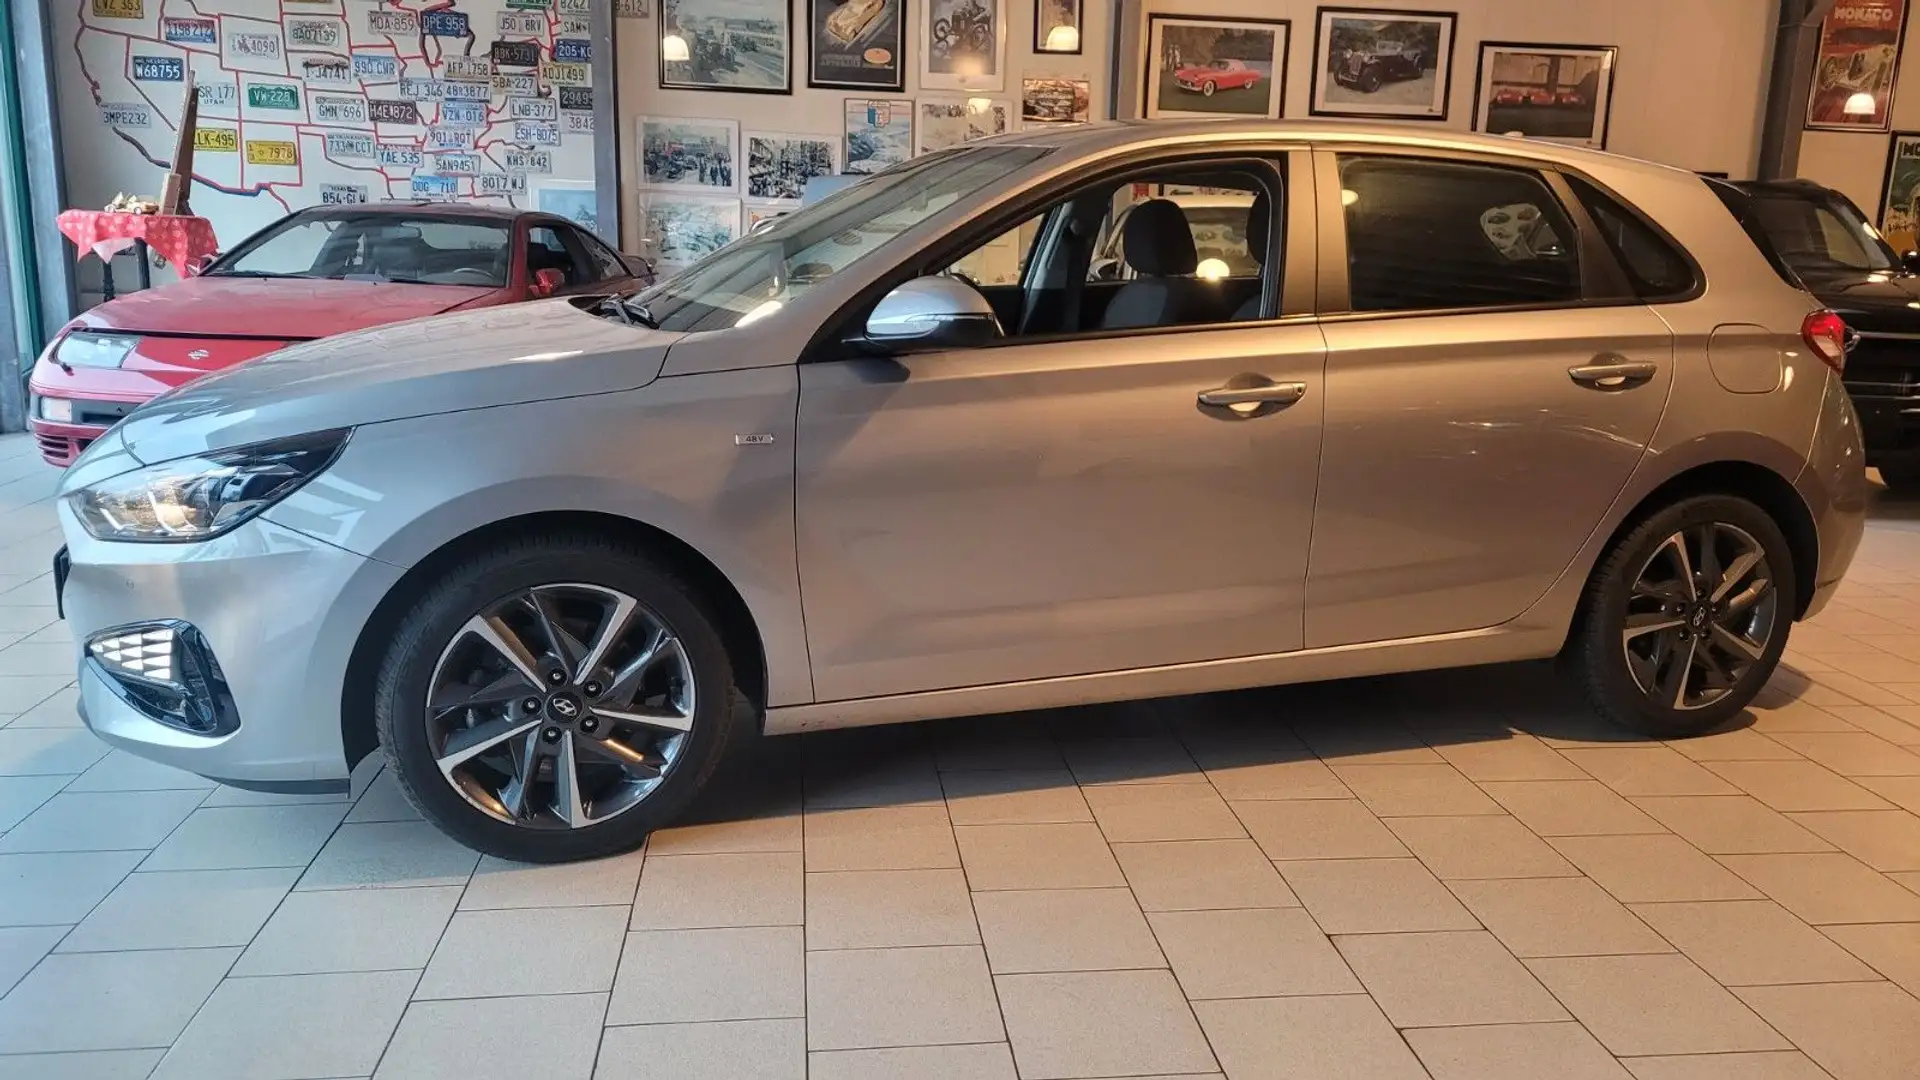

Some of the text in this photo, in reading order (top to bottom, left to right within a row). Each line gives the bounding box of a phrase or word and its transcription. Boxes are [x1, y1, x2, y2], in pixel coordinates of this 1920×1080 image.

[1834, 6, 1894, 21] MONACO
[446, 17, 466, 31] 958
[103, 111, 148, 125] 3MPE232
[343, 105, 362, 118] 696
[393, 106, 413, 119] 872
[269, 146, 293, 159] 7978
[401, 152, 420, 165] 535
[481, 176, 508, 190] 8017
[745, 435, 764, 443] 48V
